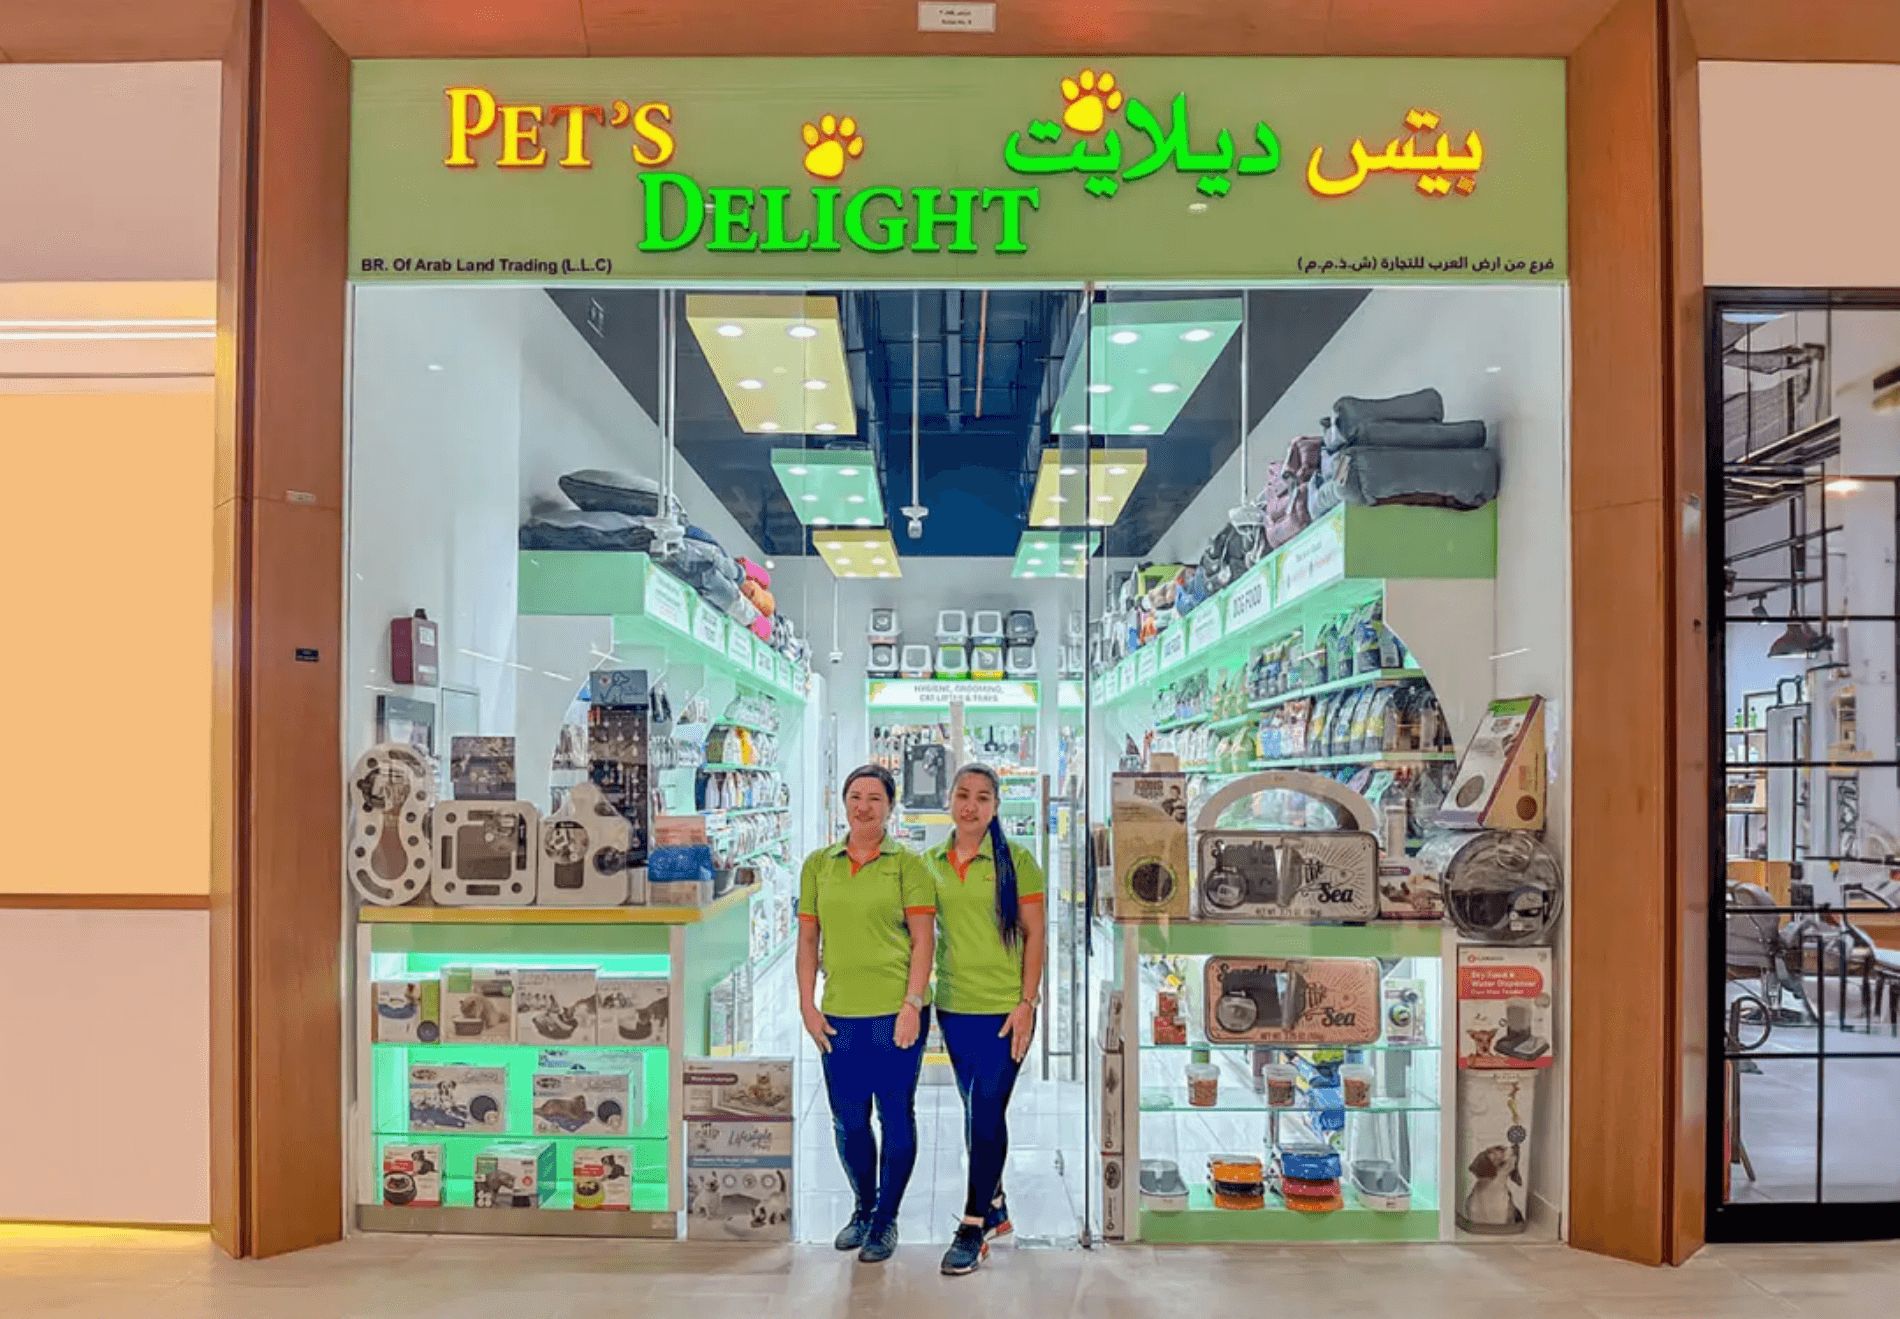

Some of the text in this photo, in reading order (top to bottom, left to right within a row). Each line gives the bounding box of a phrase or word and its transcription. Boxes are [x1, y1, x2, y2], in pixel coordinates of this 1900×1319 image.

[444, 86, 675, 168] PET'S
[1004, 91, 1281, 198] ديلايت
[1305, 107, 1485, 197] بيتس
[637, 172, 1040, 253] DELIGHT
[361, 258, 613, 275] BR. Of Arab Land Trading (L.L.C)
[1381, 256, 1424, 271] للتجارة
[1428, 256, 1467, 273] العرب
[1504, 258, 1526, 273] من
[1529, 257, 1555, 275] فرع
[1318, 882, 1354, 904] Sea
[1321, 1007, 1356, 1028] Sea
